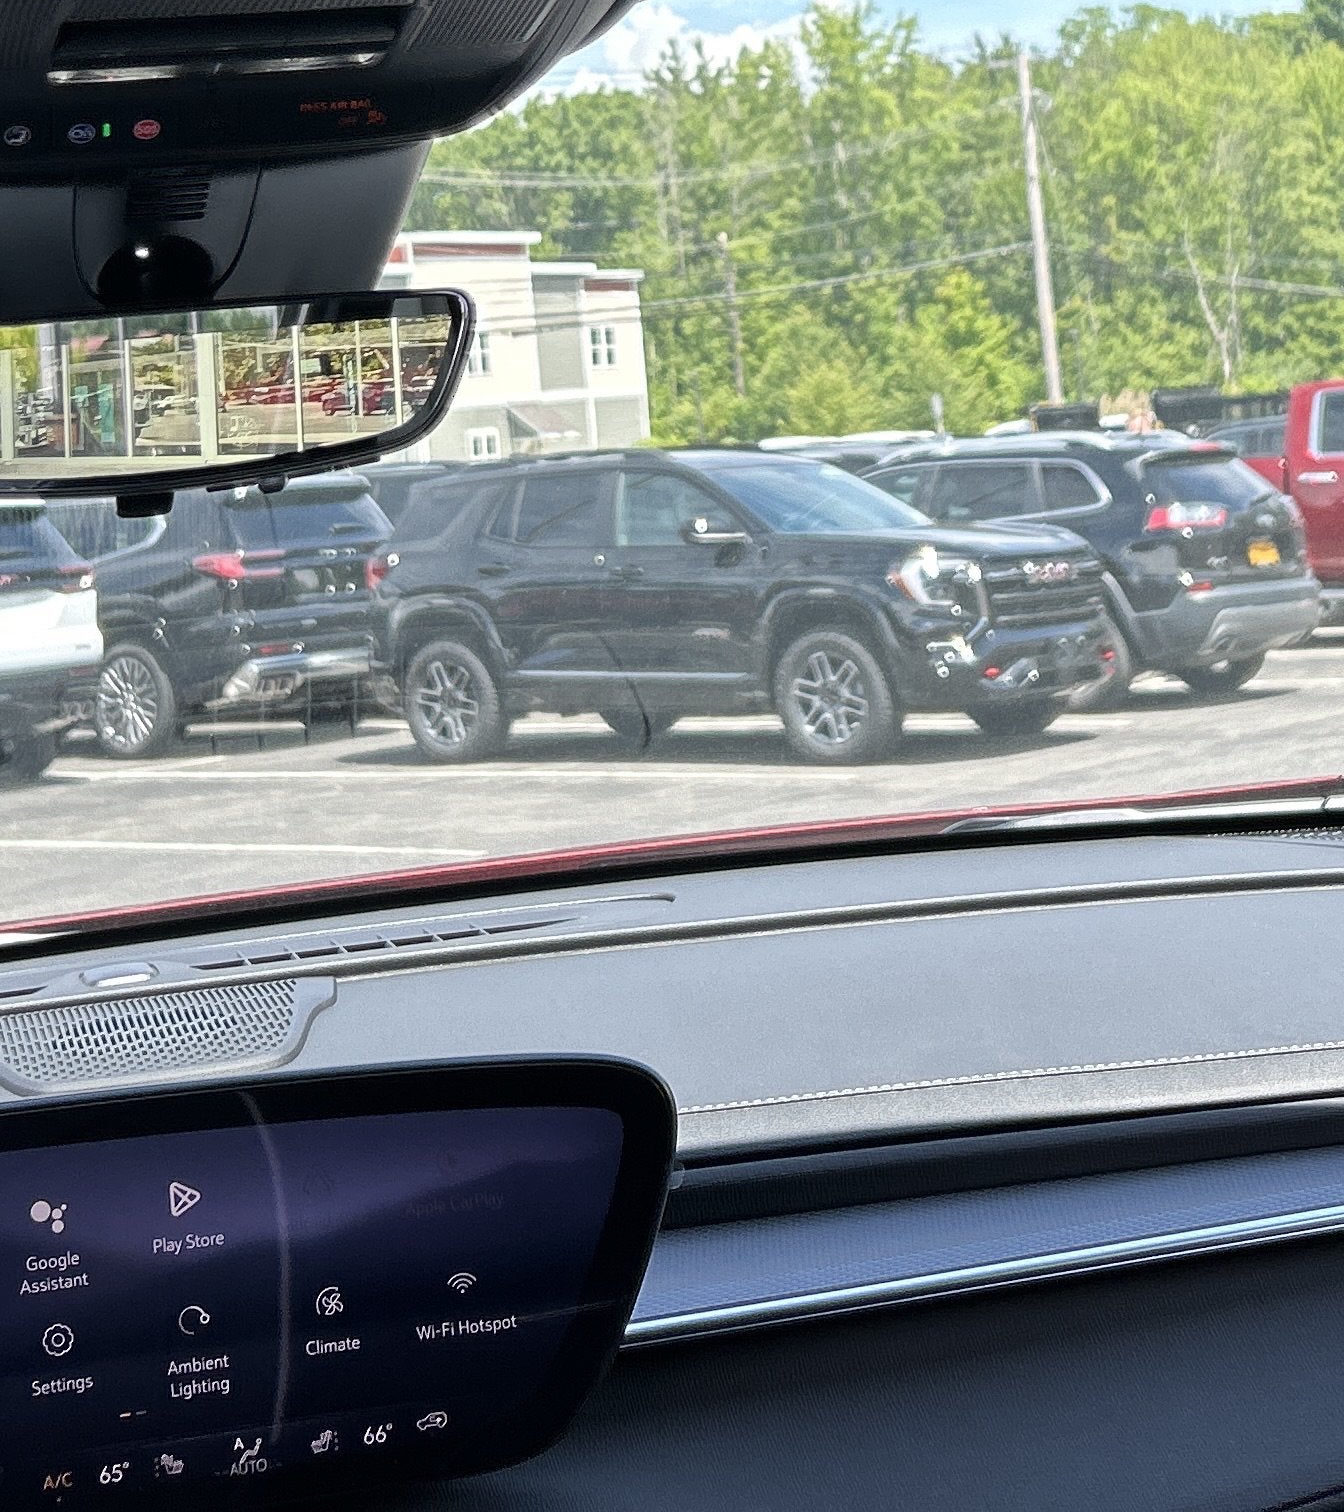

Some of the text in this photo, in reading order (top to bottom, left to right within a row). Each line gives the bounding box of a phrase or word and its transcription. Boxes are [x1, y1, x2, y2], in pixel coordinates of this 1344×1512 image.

[152, 1231, 225, 1255] Play Store
[25, 1251, 80, 1273] Google
[20, 1272, 89, 1295] Assistant
[416, 1313, 517, 1341] Wi-Fi Hotspot
[305, 1335, 360, 1356] Climate
[167, 1354, 230, 1376] Ambient
[31, 1374, 94, 1397] Settings
[169, 1377, 230, 1401] Lighting
[229, 1457, 268, 1477] AUTO
[43, 1471, 73, 1491] A/C
